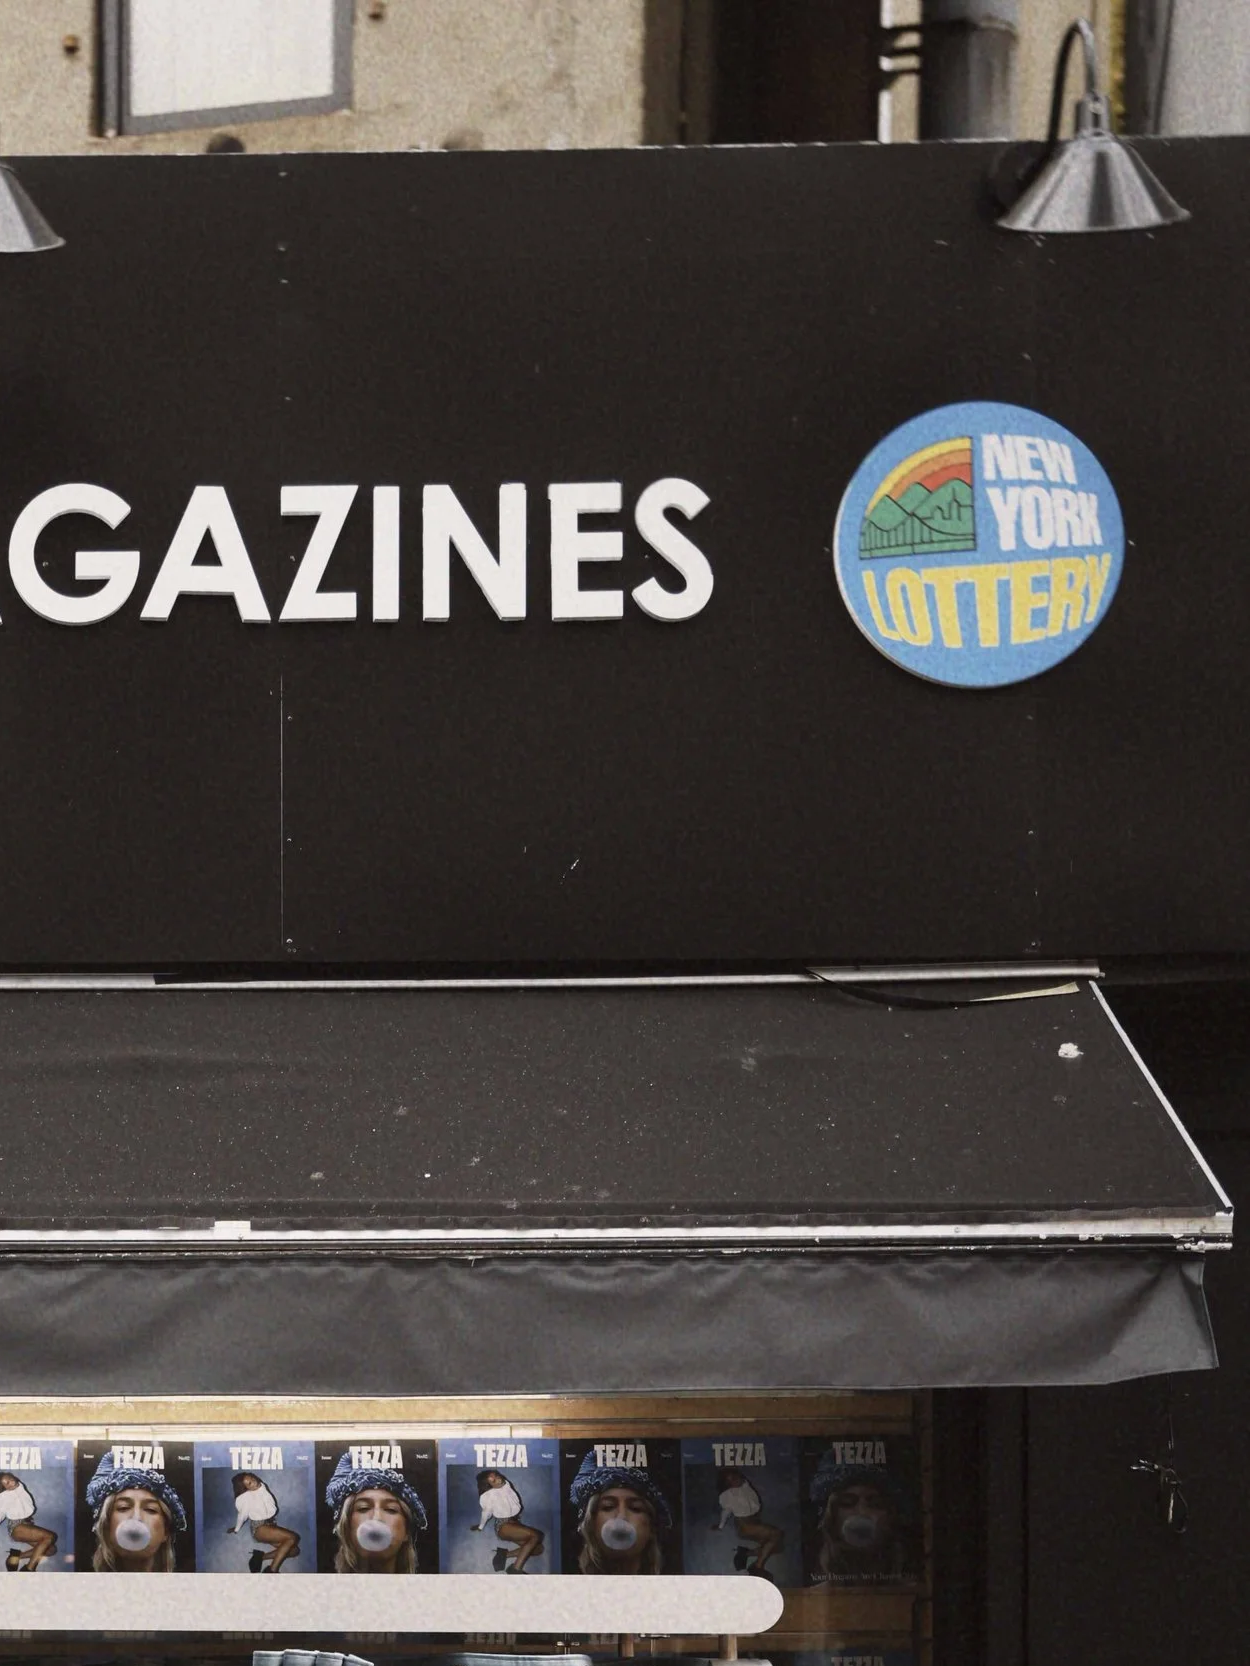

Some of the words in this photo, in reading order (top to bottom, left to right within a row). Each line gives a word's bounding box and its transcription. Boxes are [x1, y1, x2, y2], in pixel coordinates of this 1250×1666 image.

[981, 433, 1077, 485] NEW
[985, 486, 1104, 551] YORK
[862, 552, 1112, 649] LOTTERY
[111, 1445, 165, 1470] TEZZA
[229, 1446, 283, 1470] TEZZA
[349, 1445, 403, 1469] TEZZA
[474, 1444, 528, 1468] TEZZA
[594, 1444, 647, 1468] TEZZA
[712, 1443, 766, 1467] TEZZA
[832, 1441, 886, 1465] TEZZA
